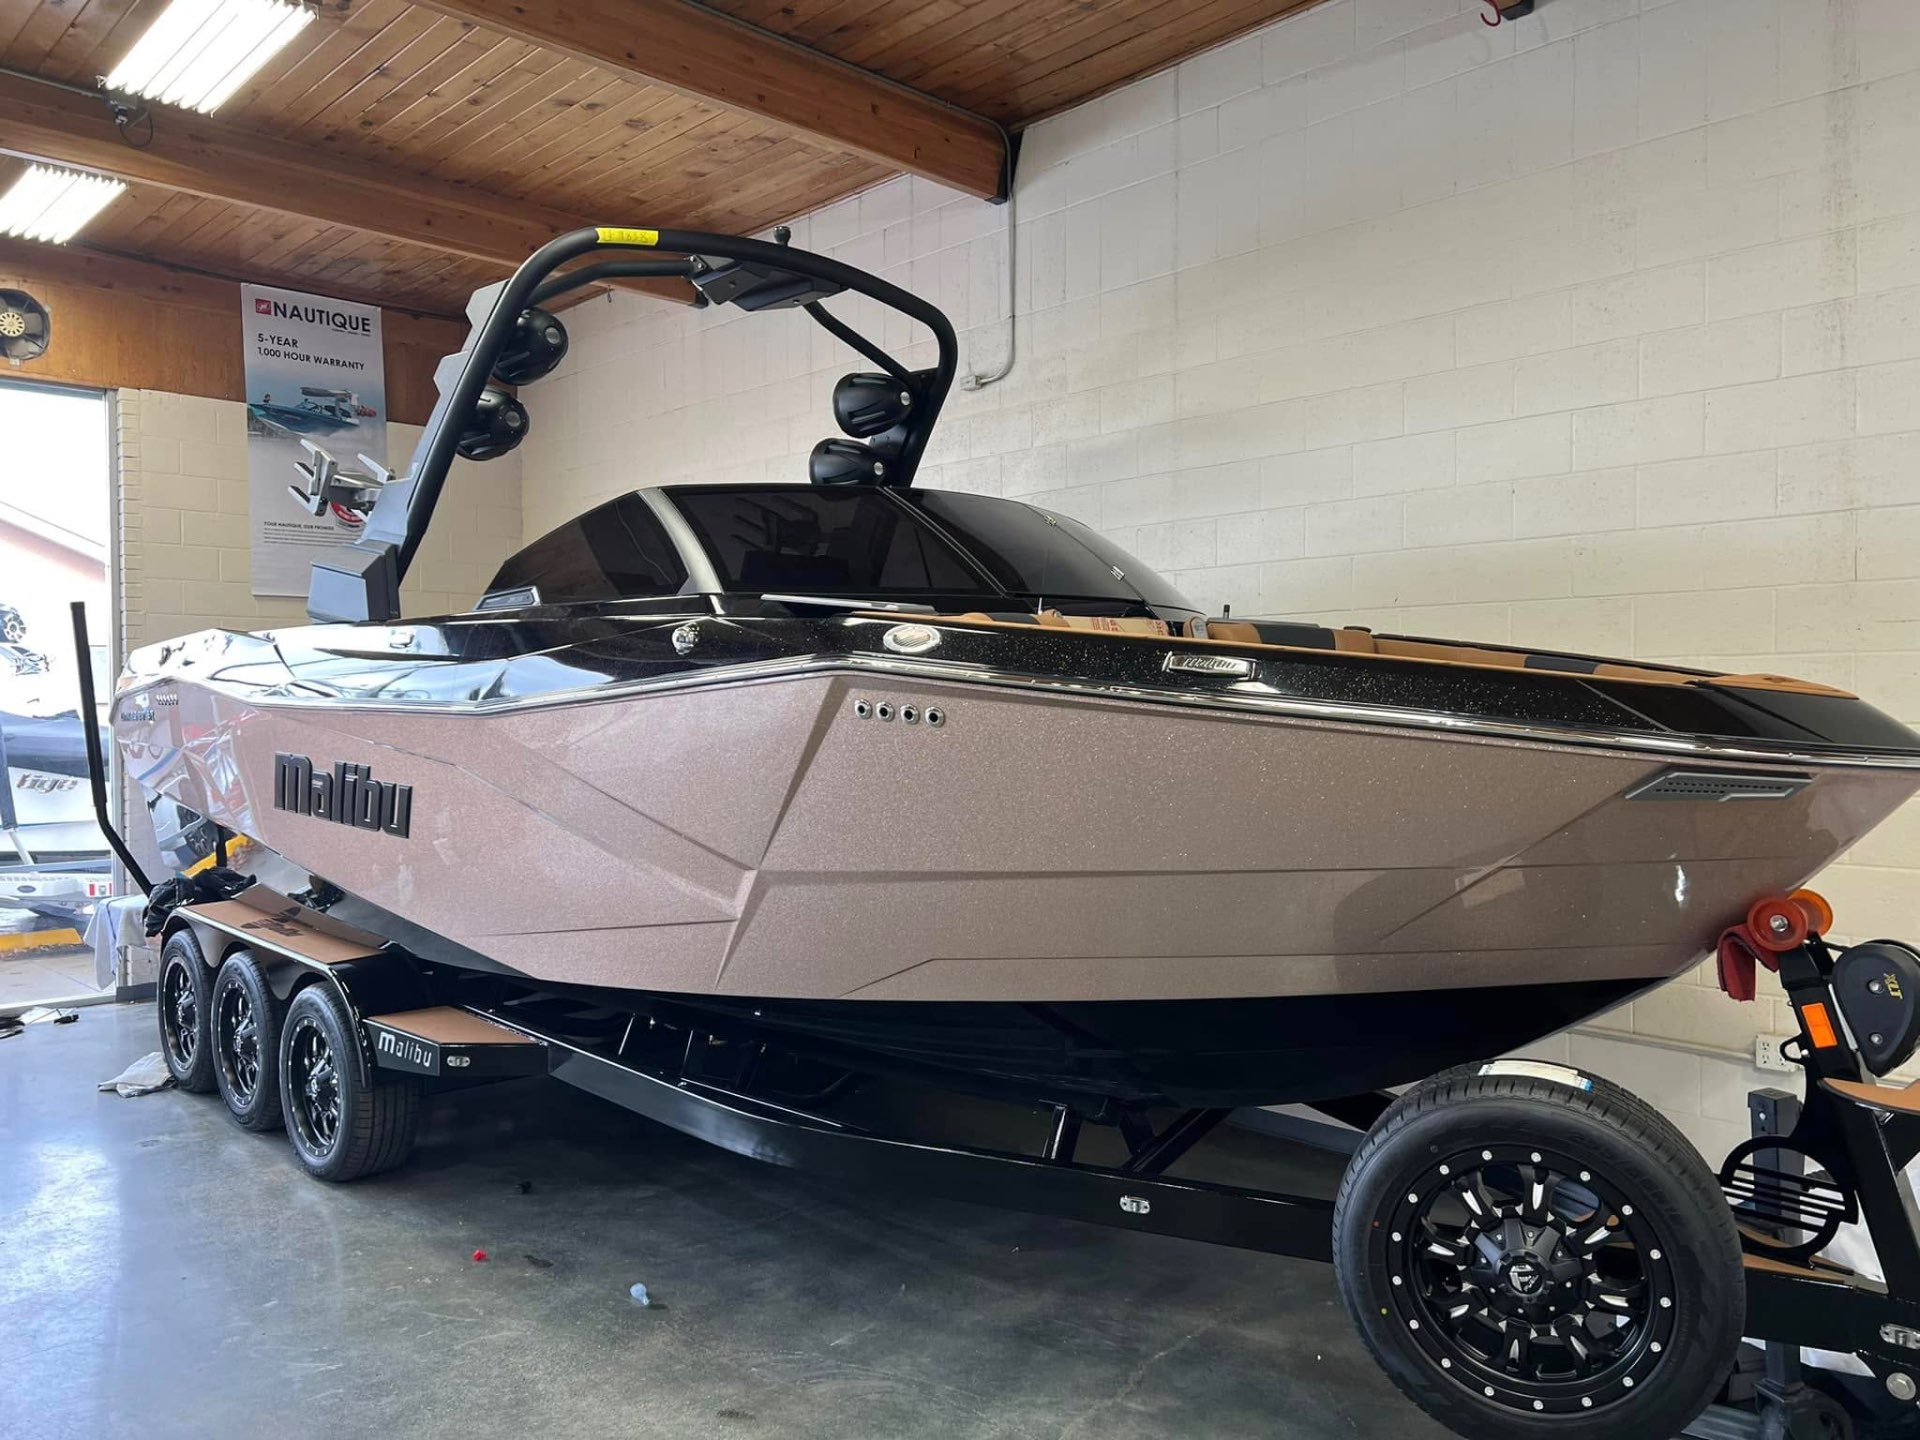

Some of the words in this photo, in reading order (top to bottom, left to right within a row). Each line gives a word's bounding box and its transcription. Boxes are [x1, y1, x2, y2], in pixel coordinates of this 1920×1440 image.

[273, 301, 371, 333] NAUTIQUE
[257, 333, 299, 348] 5-YEAR
[283, 351, 311, 363] HOUR
[313, 355, 365, 371] WARRANTY
[274, 751, 413, 839] Malibu
